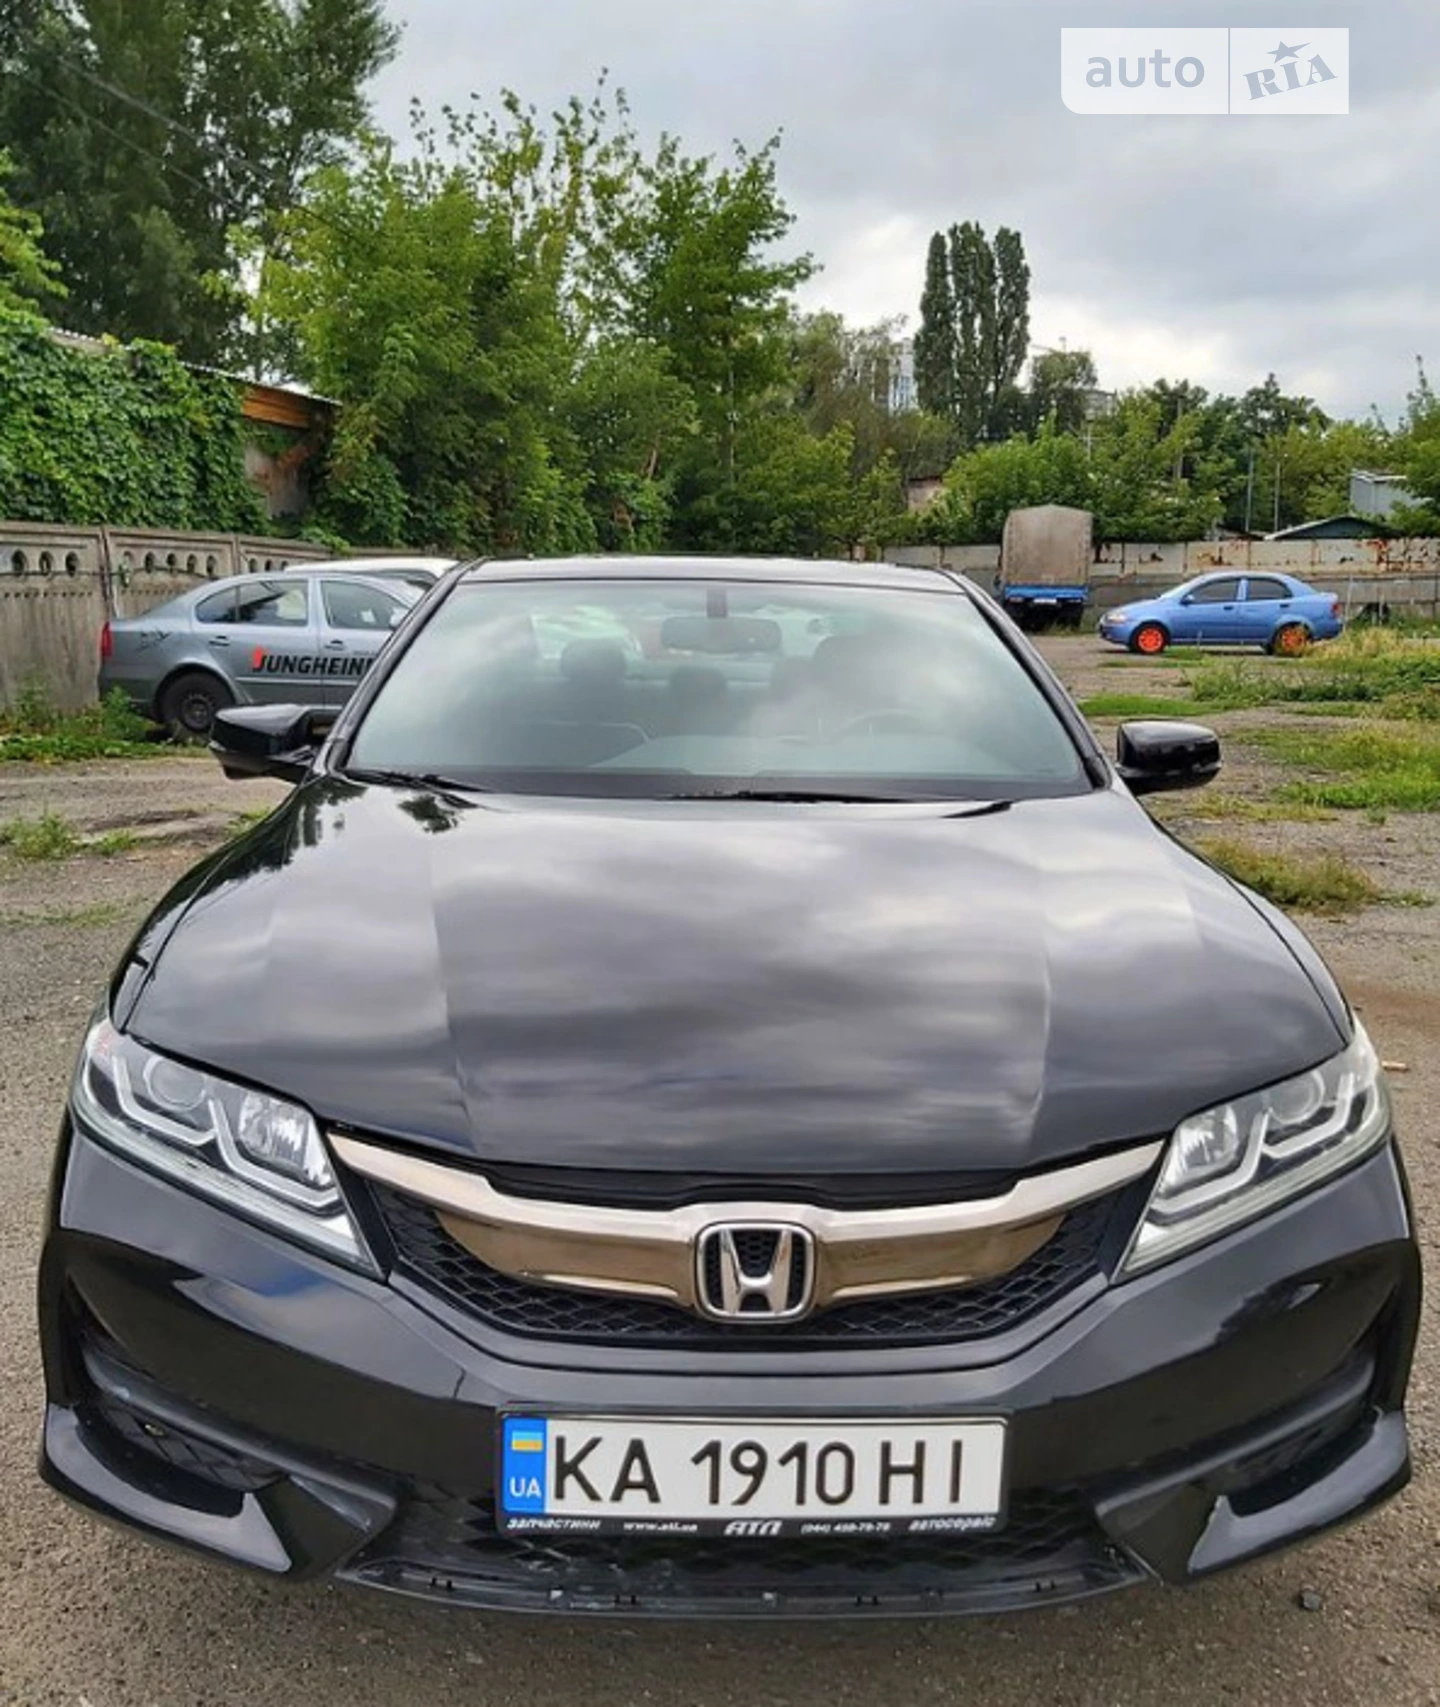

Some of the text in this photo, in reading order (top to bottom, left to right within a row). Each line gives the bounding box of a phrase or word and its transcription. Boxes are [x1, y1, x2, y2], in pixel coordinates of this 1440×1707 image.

[509, 1477, 541, 1498] UA
[554, 1435, 661, 1503] KA
[690, 1439, 855, 1506] 1910
